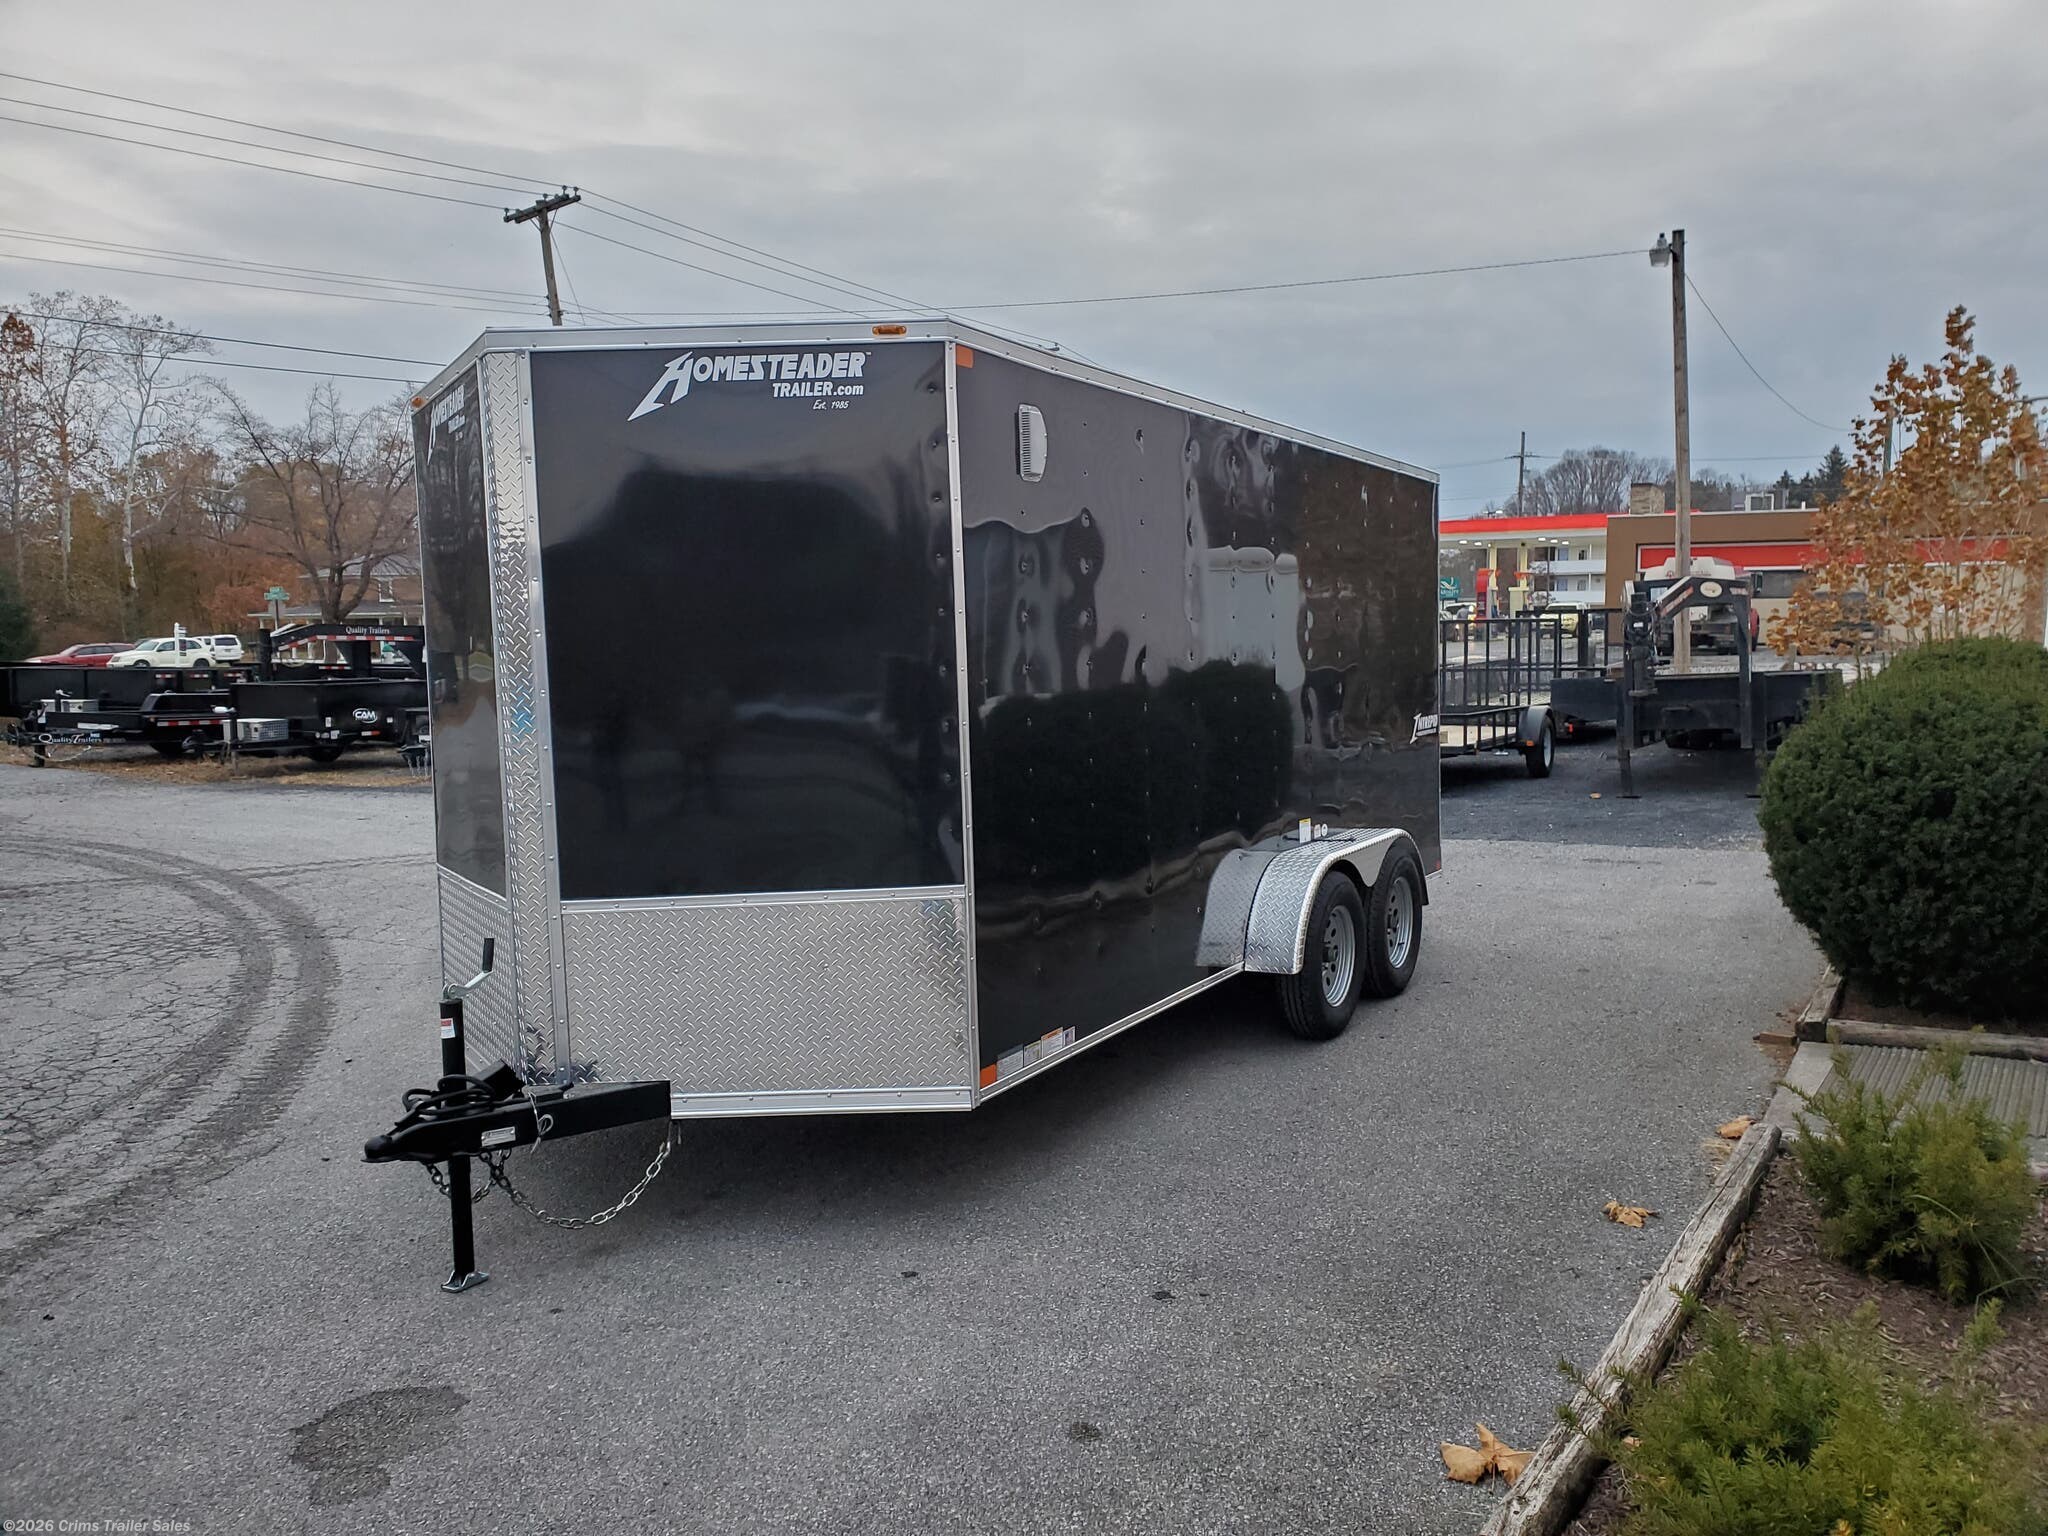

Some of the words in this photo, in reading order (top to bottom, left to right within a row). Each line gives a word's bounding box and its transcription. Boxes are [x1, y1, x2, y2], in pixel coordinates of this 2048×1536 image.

[628, 351, 866, 421] HOMESTEADER
[772, 381, 864, 398] TRAILER.com
[830, 400, 850, 409] 1985
[346, 625, 367, 636] Quality
[368, 626, 390, 635] Trailers
[355, 711, 376, 719] CAM
